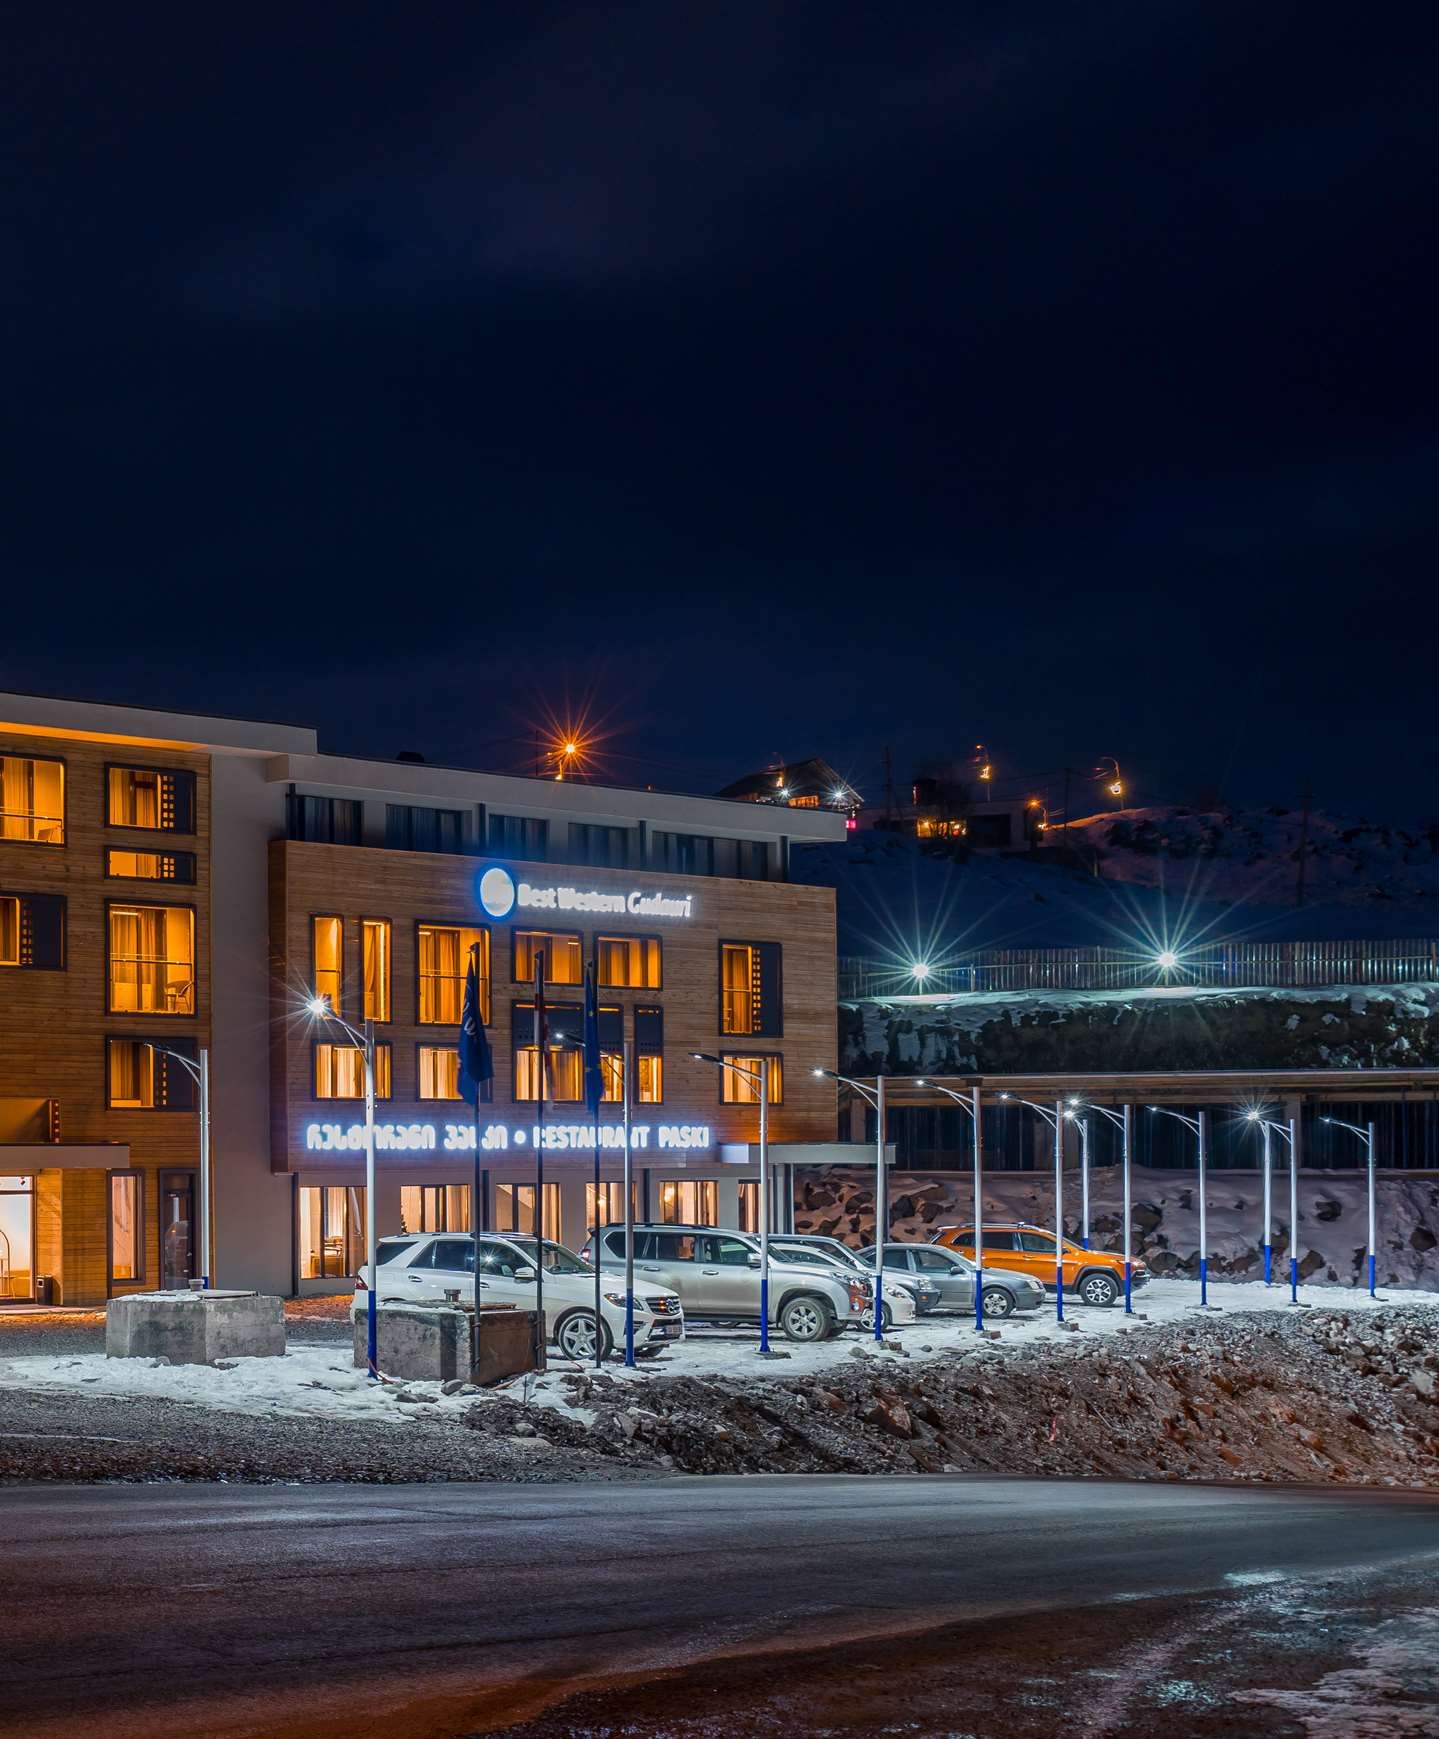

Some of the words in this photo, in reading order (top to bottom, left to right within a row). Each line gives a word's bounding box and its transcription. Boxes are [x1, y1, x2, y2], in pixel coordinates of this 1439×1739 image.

[517, 883, 556, 909] Best
[557, 887, 625, 913] Western
[658, 1125, 710, 1149] PASKI
